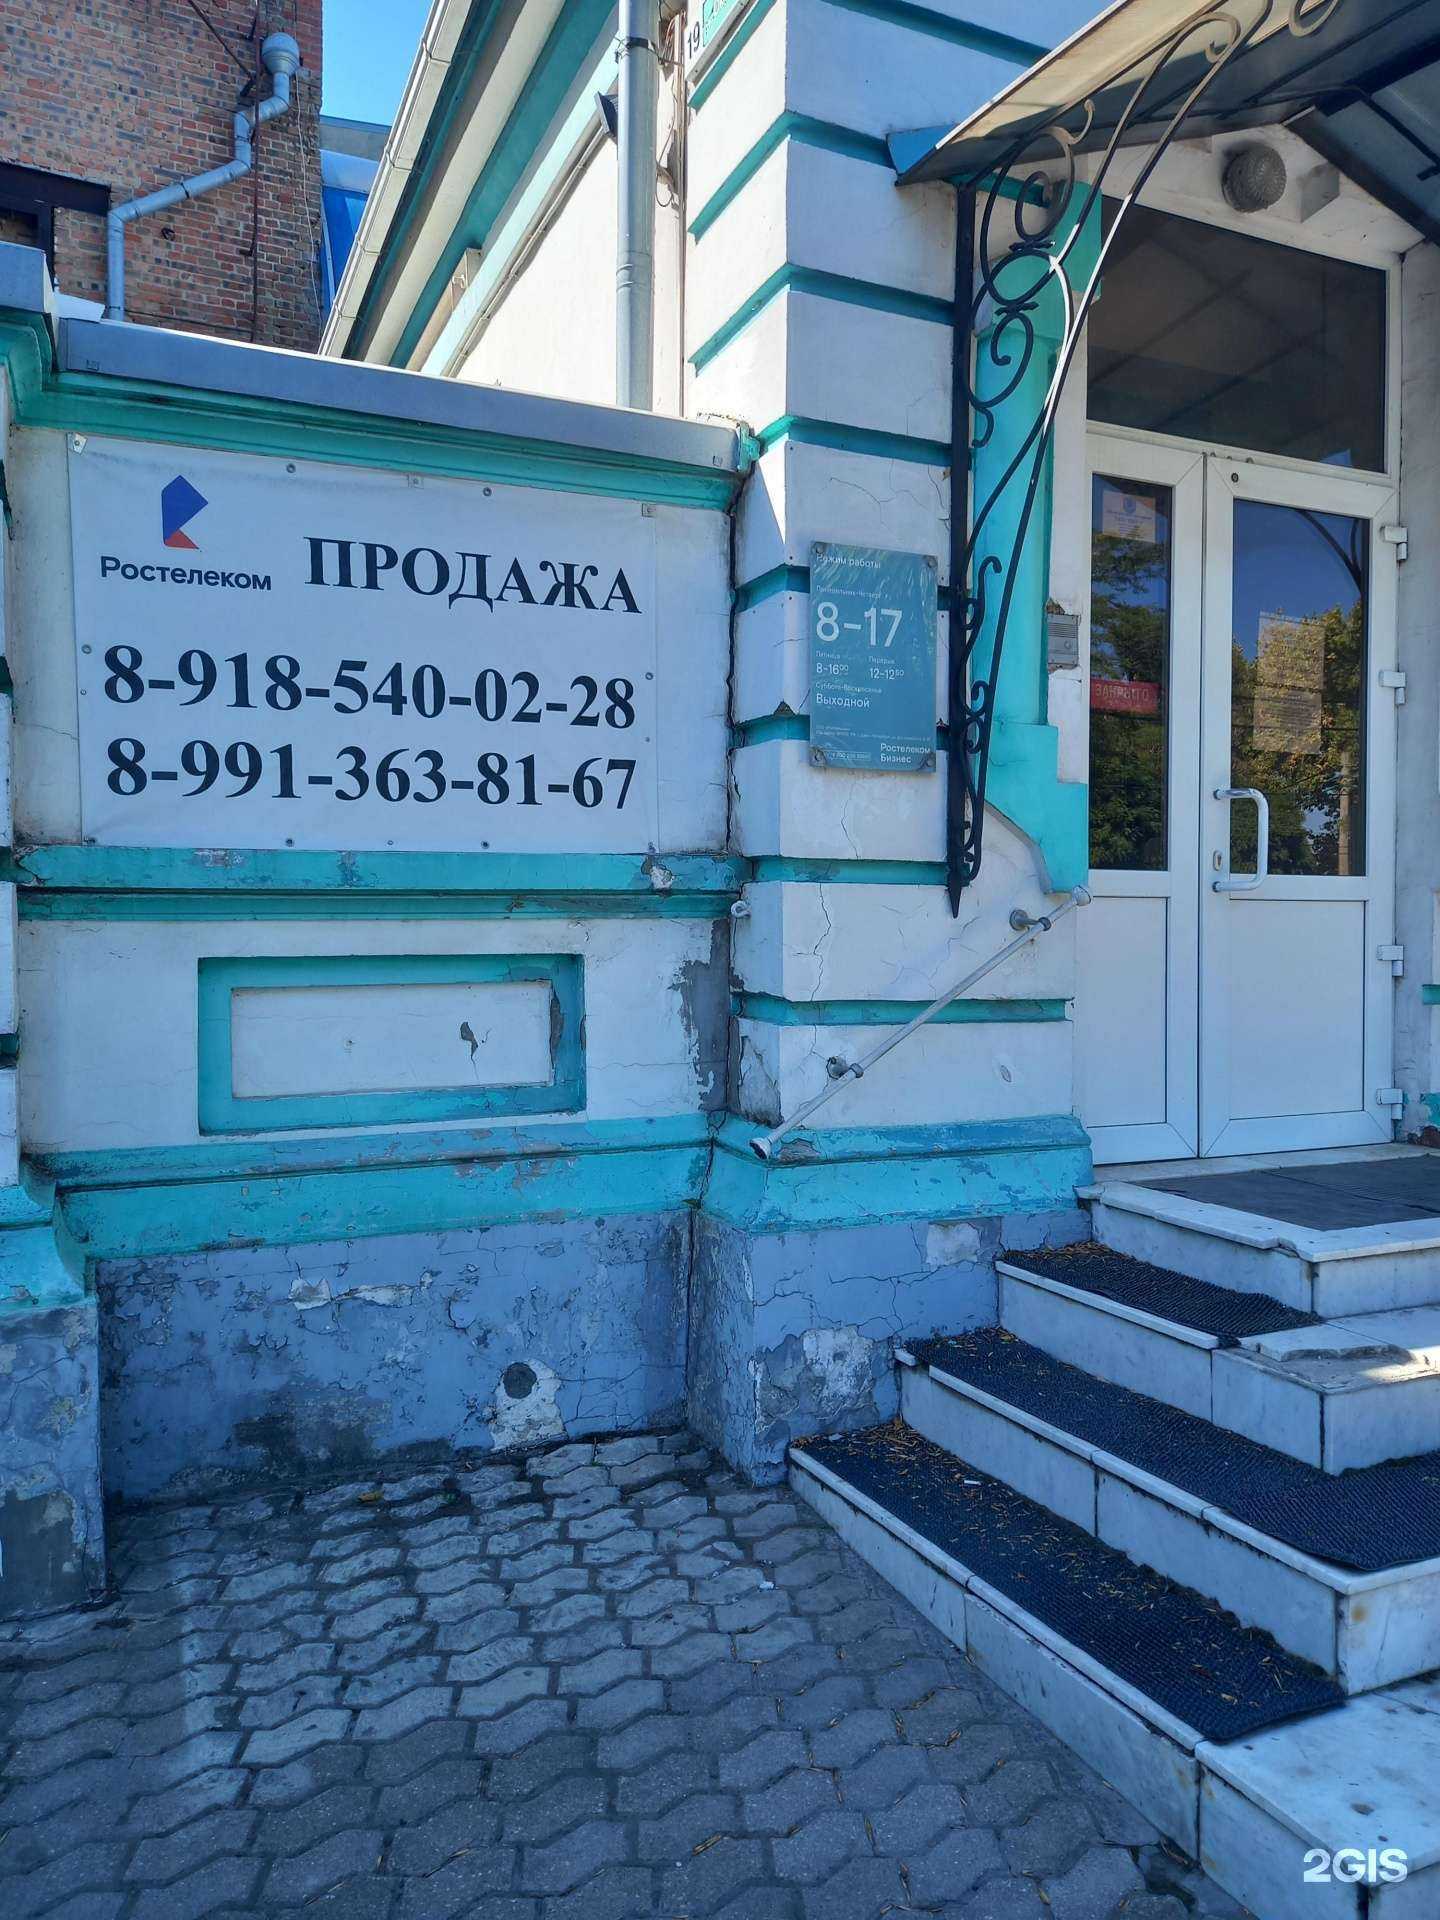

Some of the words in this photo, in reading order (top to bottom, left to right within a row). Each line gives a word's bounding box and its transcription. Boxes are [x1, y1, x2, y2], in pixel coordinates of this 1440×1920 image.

[101, 555, 272, 591] Ростелеком
[302, 536, 642, 614] ПРОДАЖА
[816, 553, 847, 565] Режим
[849, 558, 881, 569] работы
[816, 602, 903, 648] 8-17
[103, 644, 637, 729] 8-918-540-02-28
[816, 693, 871, 708] Выходной
[880, 743, 931, 755] Ростелеком
[880, 753, 912, 763] Бизнес
[106, 737, 637, 810] 8-991-363-81-67
